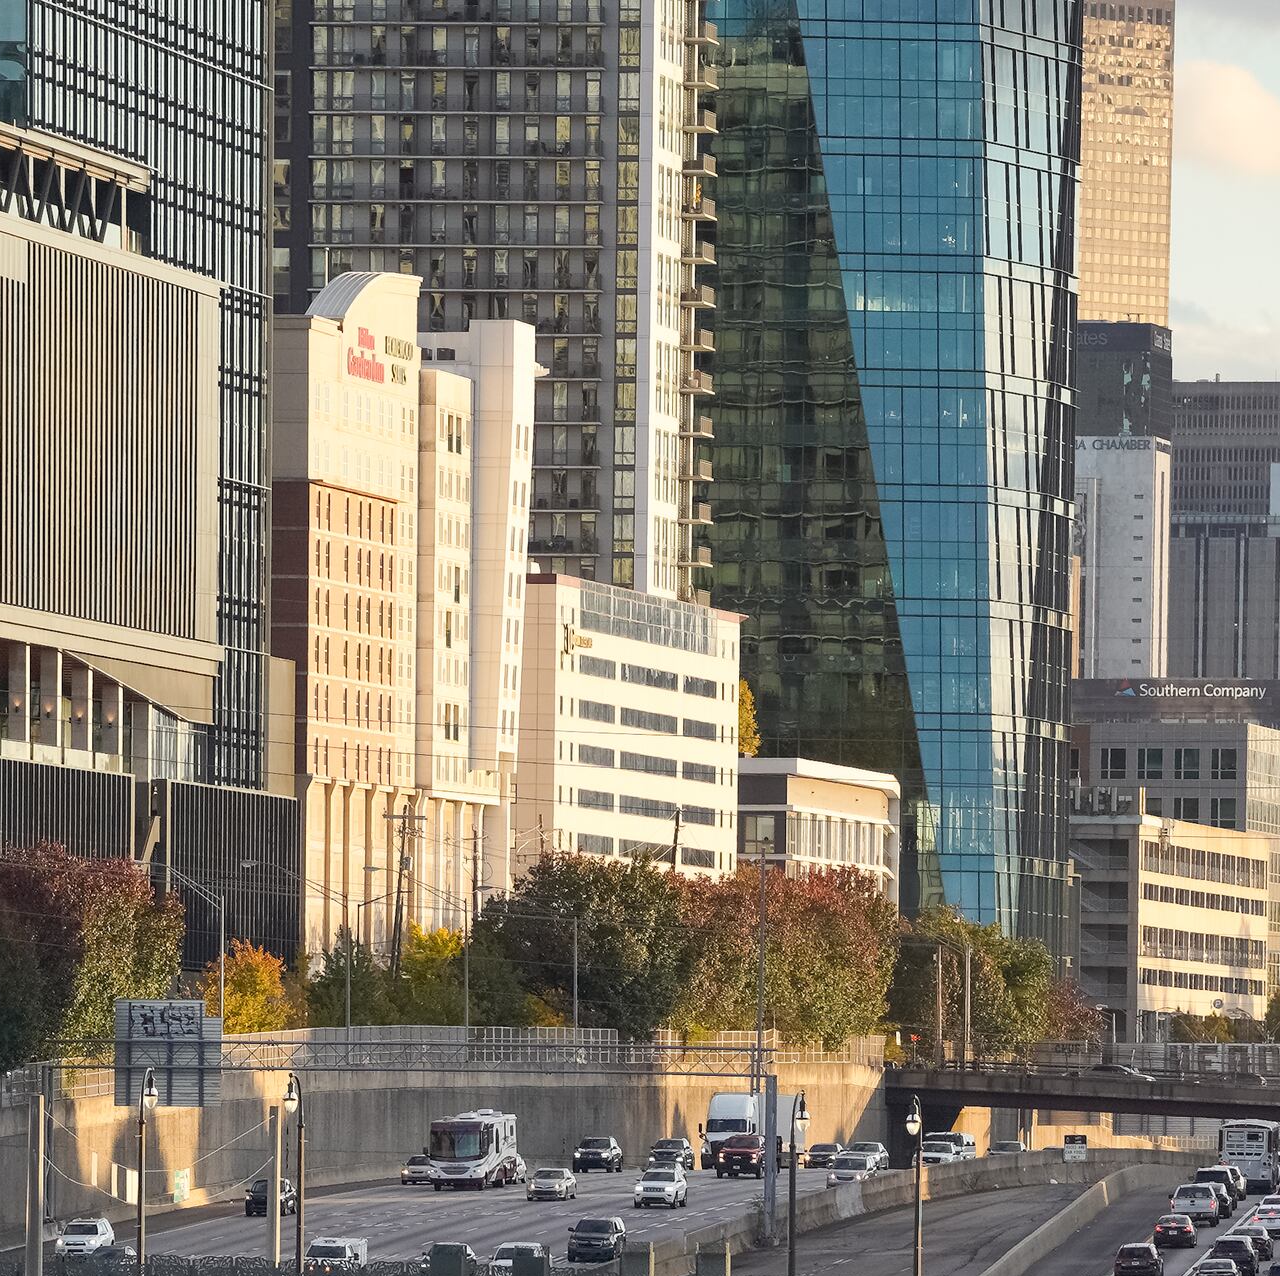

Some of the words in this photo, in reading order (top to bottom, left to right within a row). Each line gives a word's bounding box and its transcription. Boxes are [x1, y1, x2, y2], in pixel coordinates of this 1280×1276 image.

[1092, 439, 1151, 450] CHAMBER
[1139, 683, 1200, 698] Southern
[1204, 684, 1266, 700] Company
